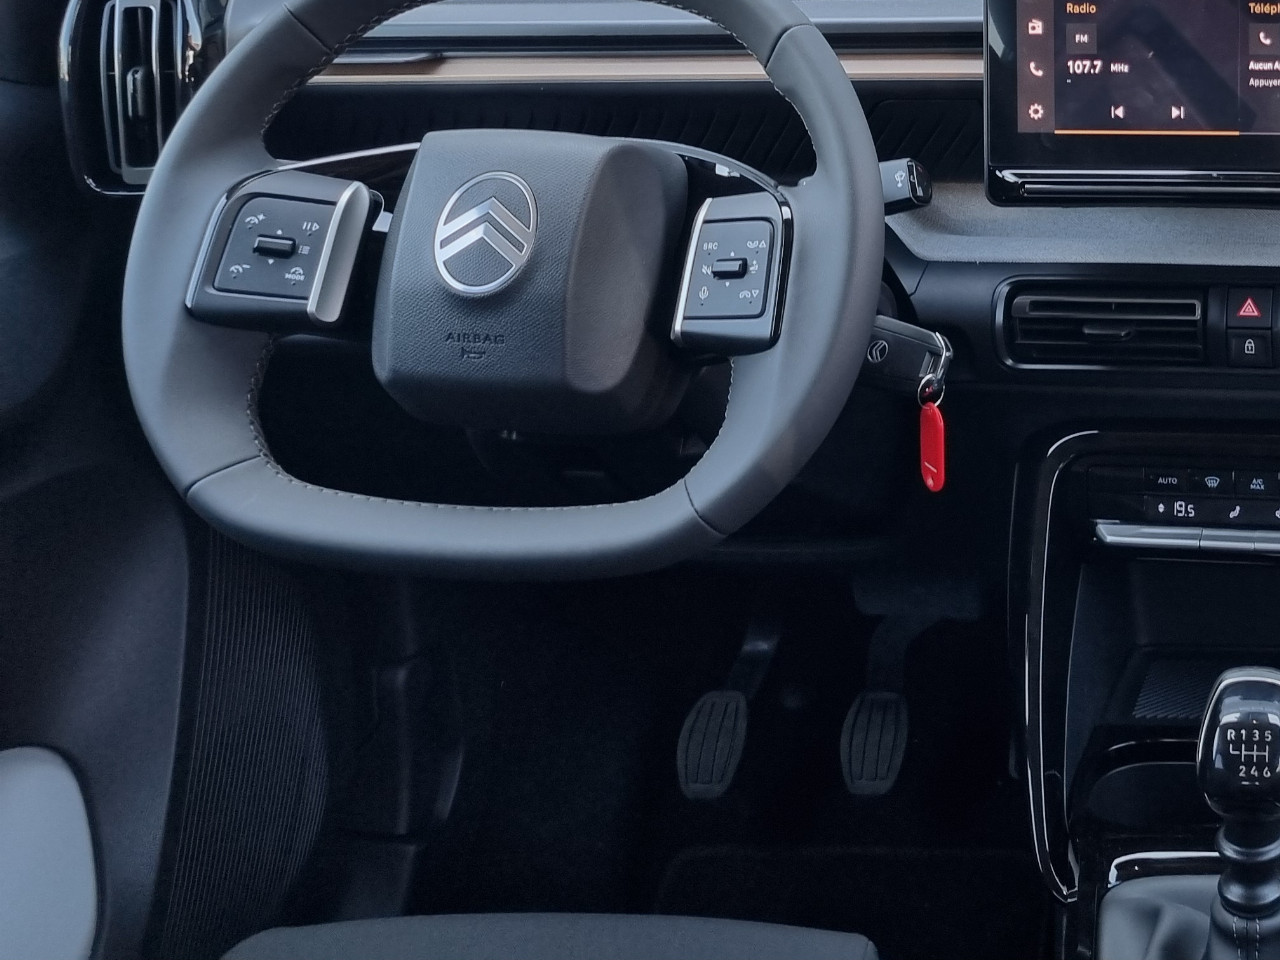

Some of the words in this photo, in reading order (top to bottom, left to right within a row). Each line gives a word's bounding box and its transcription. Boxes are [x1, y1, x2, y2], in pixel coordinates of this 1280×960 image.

[1066, 2, 1097, 14] Radio
[1075, 34, 1088, 43] FM
[1067, 59, 1102, 74] 107.7
[1110, 63, 1129, 73] MHz
[1249, 60, 1272, 70] Aucun
[1249, 77, 1280, 87] Appuyer
[285, 273, 305, 281] MODE
[446, 332, 505, 344] AIRBAG
[1174, 500, 1195, 517] 19.5
[1227, 729, 1236, 740] R
[1240, 729, 1246, 740] 1
[1252, 730, 1260, 740] 3
[1264, 731, 1272, 740] 5
[1239, 766, 1246, 777] 2
[1250, 766, 1258, 777] 4
[1263, 766, 1271, 777] 6
